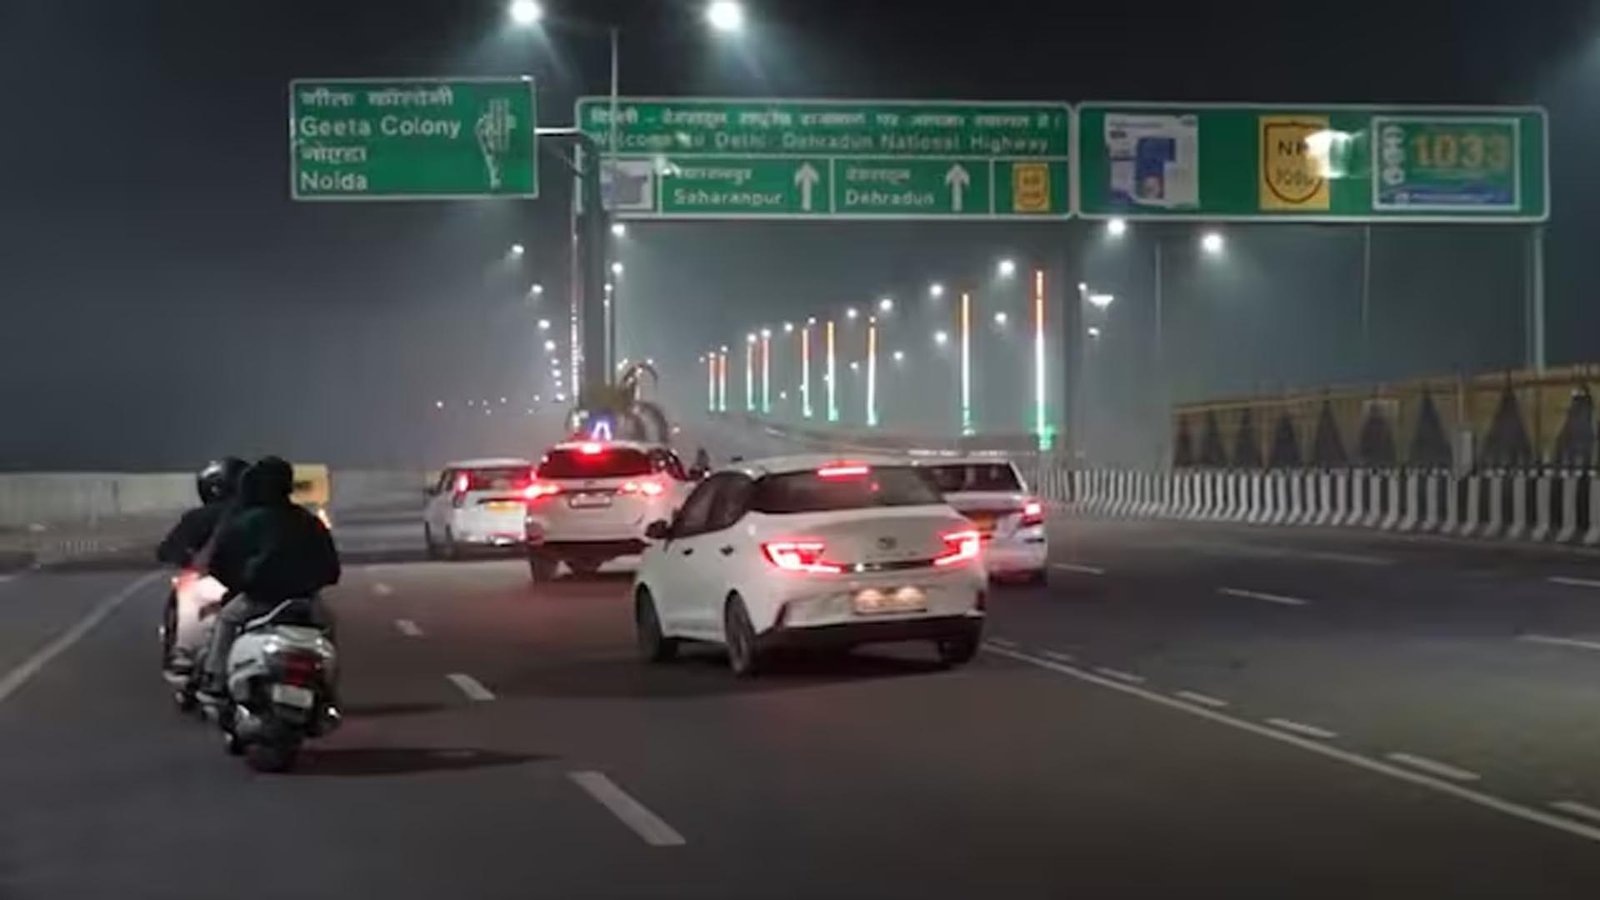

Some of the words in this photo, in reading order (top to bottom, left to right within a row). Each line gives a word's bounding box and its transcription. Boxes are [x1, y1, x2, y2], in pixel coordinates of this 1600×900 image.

[300, 116, 372, 137] Geeta
[380, 115, 462, 139] Colony
[592, 130, 674, 149] Wlco
[714, 131, 767, 148] Delhi
[782, 131, 874, 149] Dehradun
[880, 133, 961, 151] National
[969, 134, 1049, 154] Highway
[1411, 133, 1509, 168] 1033
[300, 172, 368, 191] Noida
[672, 188, 784, 208] Saharanpur
[844, 189, 936, 207] Dehradun
